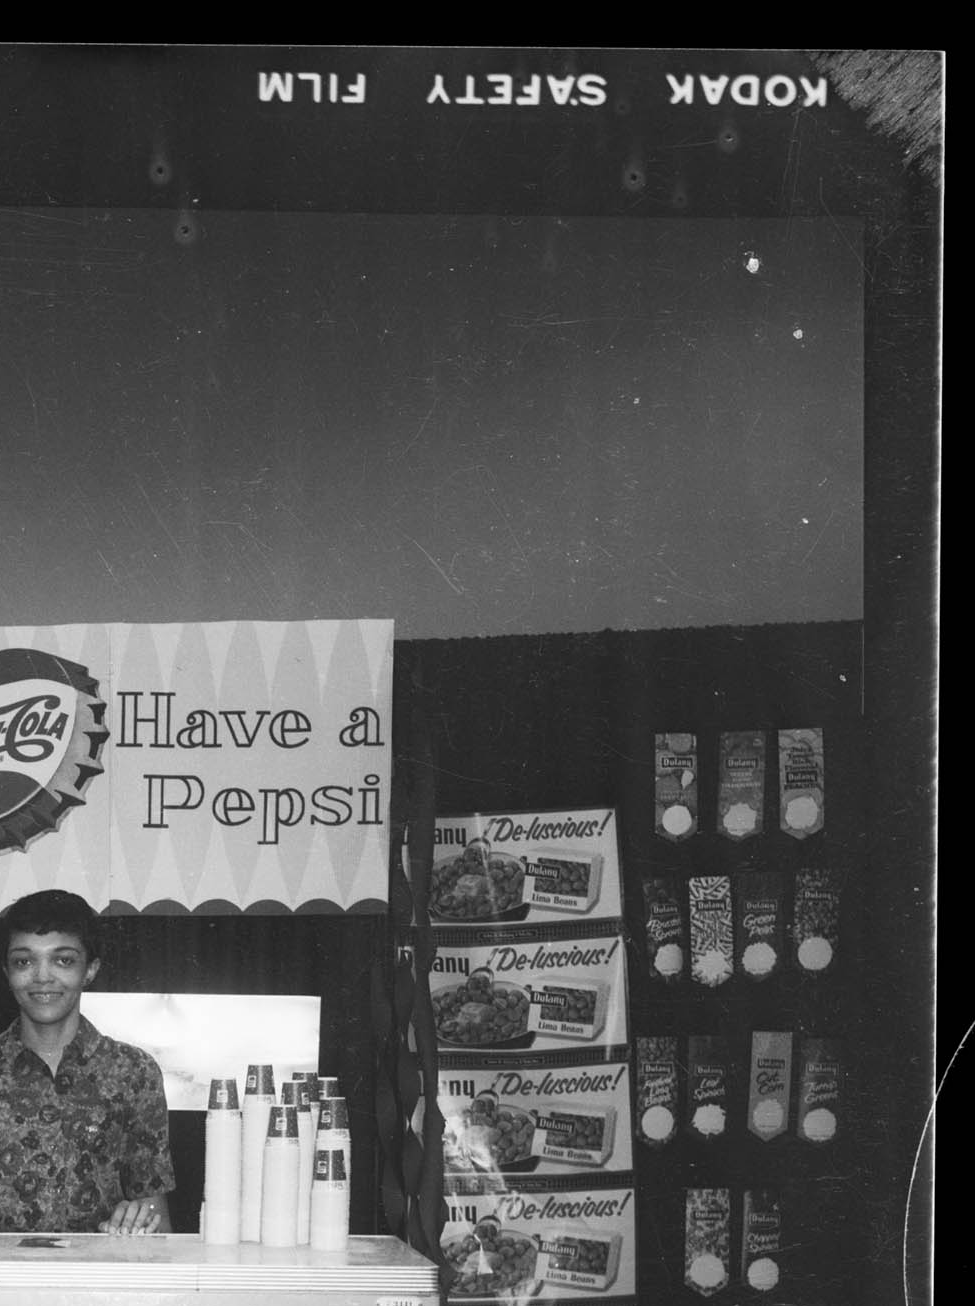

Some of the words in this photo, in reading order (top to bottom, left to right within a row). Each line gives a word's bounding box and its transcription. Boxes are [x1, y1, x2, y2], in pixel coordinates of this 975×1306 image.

[258, 73, 366, 104] FILM
[427, 73, 607, 105] SAFETY
[666, 74, 827, 107] KODAK
[116, 691, 311, 748] Have
[338, 707, 384, 747] a
[143, 774, 383, 845] Pepsi
[493, 811, 613, 842] De-luscious!
[496, 940, 619, 971] De-luscious!
[501, 1066, 626, 1095] De-luscious!
